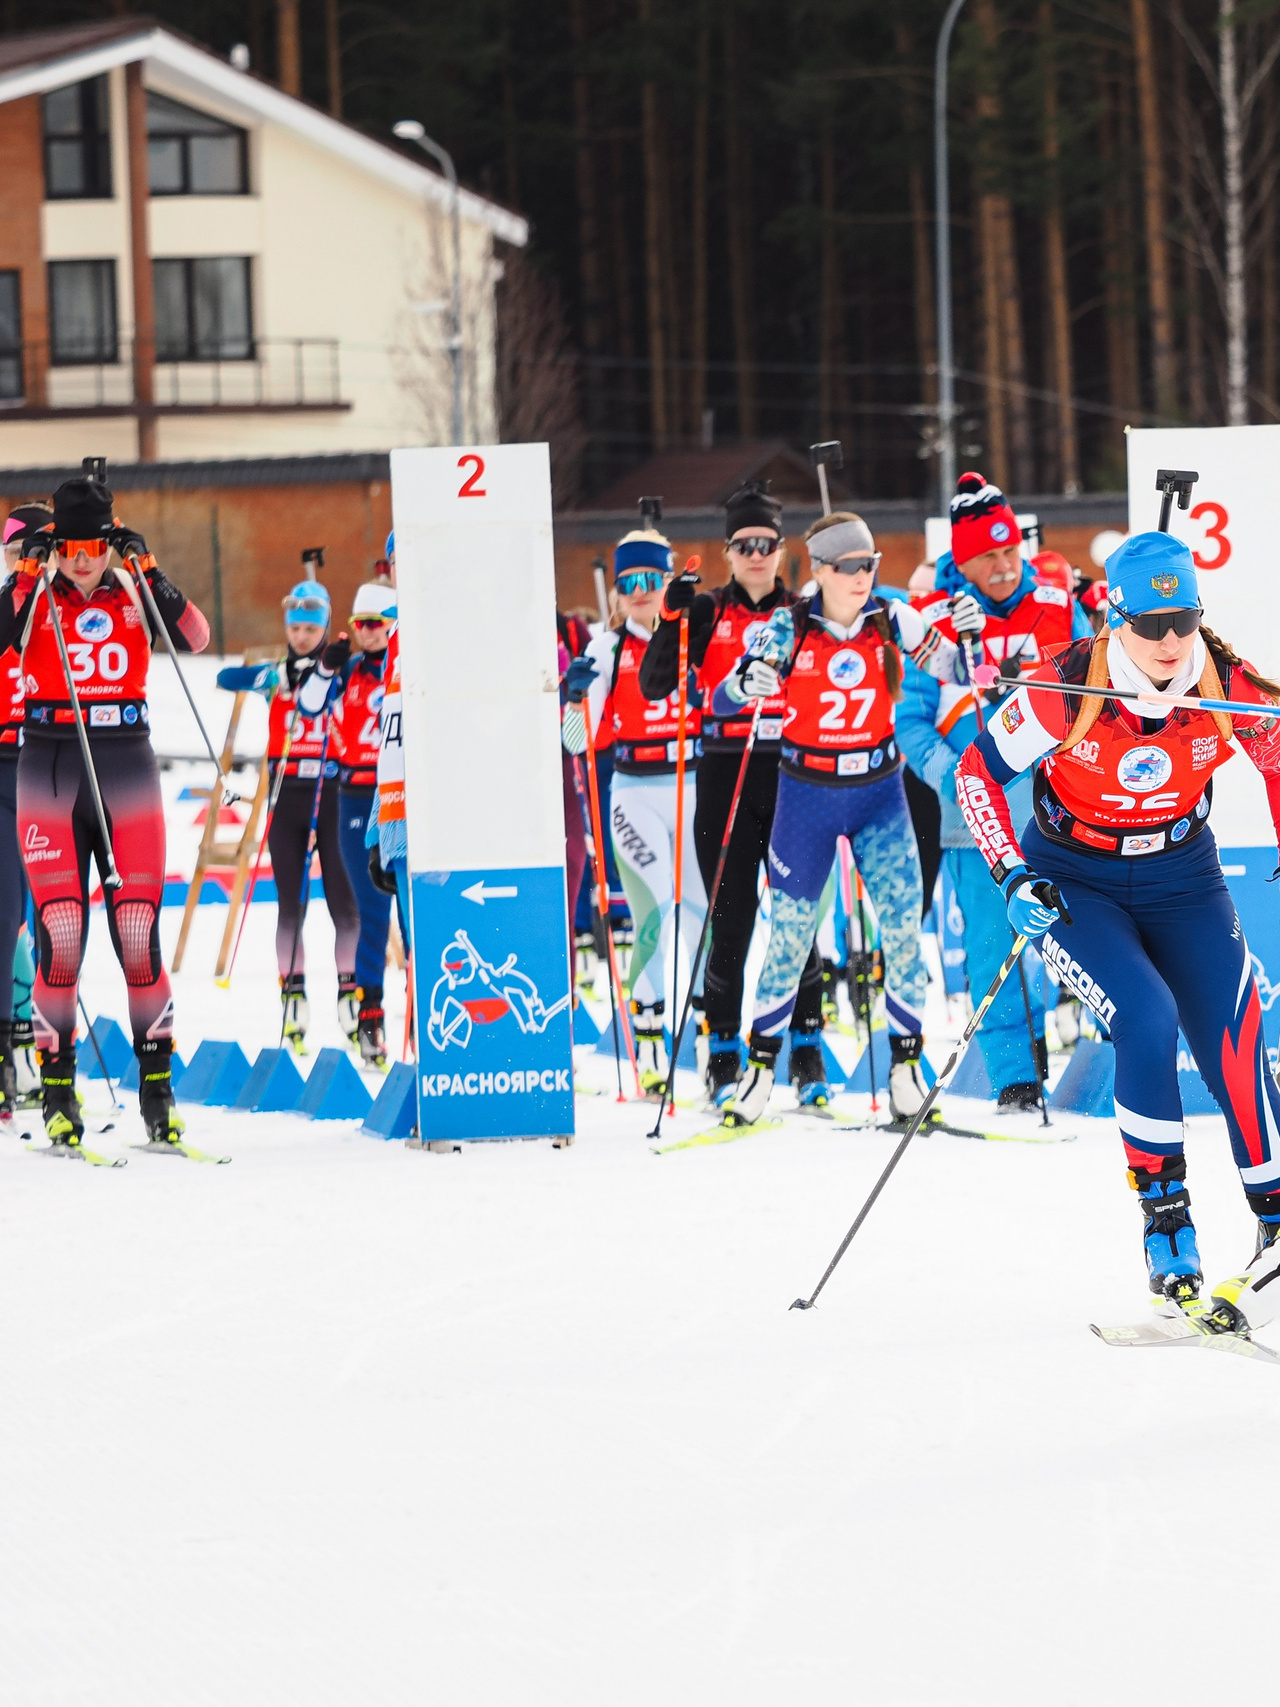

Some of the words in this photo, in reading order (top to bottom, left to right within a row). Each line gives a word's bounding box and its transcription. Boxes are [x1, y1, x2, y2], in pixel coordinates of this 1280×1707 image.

[457, 454, 487, 498] 2
[1189, 501, 1232, 571] 3
[66, 643, 129, 681] 30
[818, 688, 877, 730] 27
[422, 1069, 571, 1097] КРАСНОЯРСК
[1154, 1200, 1185, 1213] SPINE
